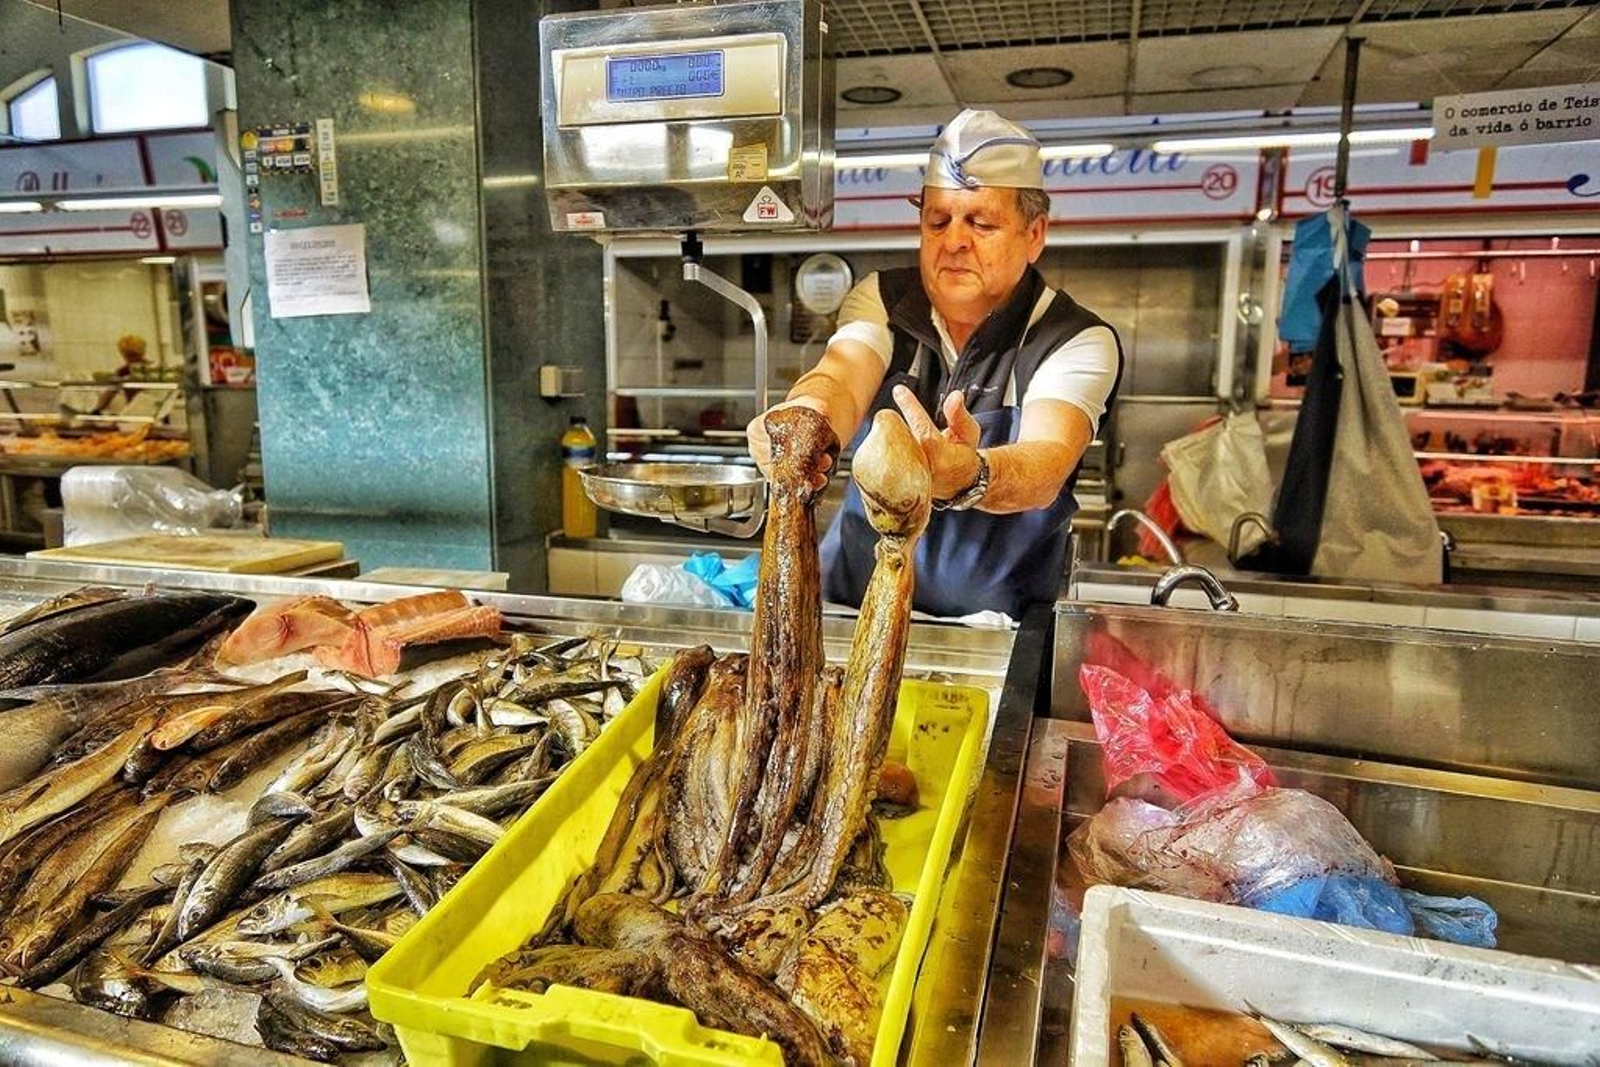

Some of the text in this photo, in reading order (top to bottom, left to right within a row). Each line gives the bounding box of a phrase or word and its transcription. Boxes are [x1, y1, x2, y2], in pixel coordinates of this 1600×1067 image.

[1444, 107, 1455, 119] O
[1460, 101, 1532, 118] comercio
[1538, 99, 1558, 112] de
[1449, 115, 1592, 137] da vida ó barrio
[1207, 172, 1237, 191] 20
[760, 206, 776, 217] FW
